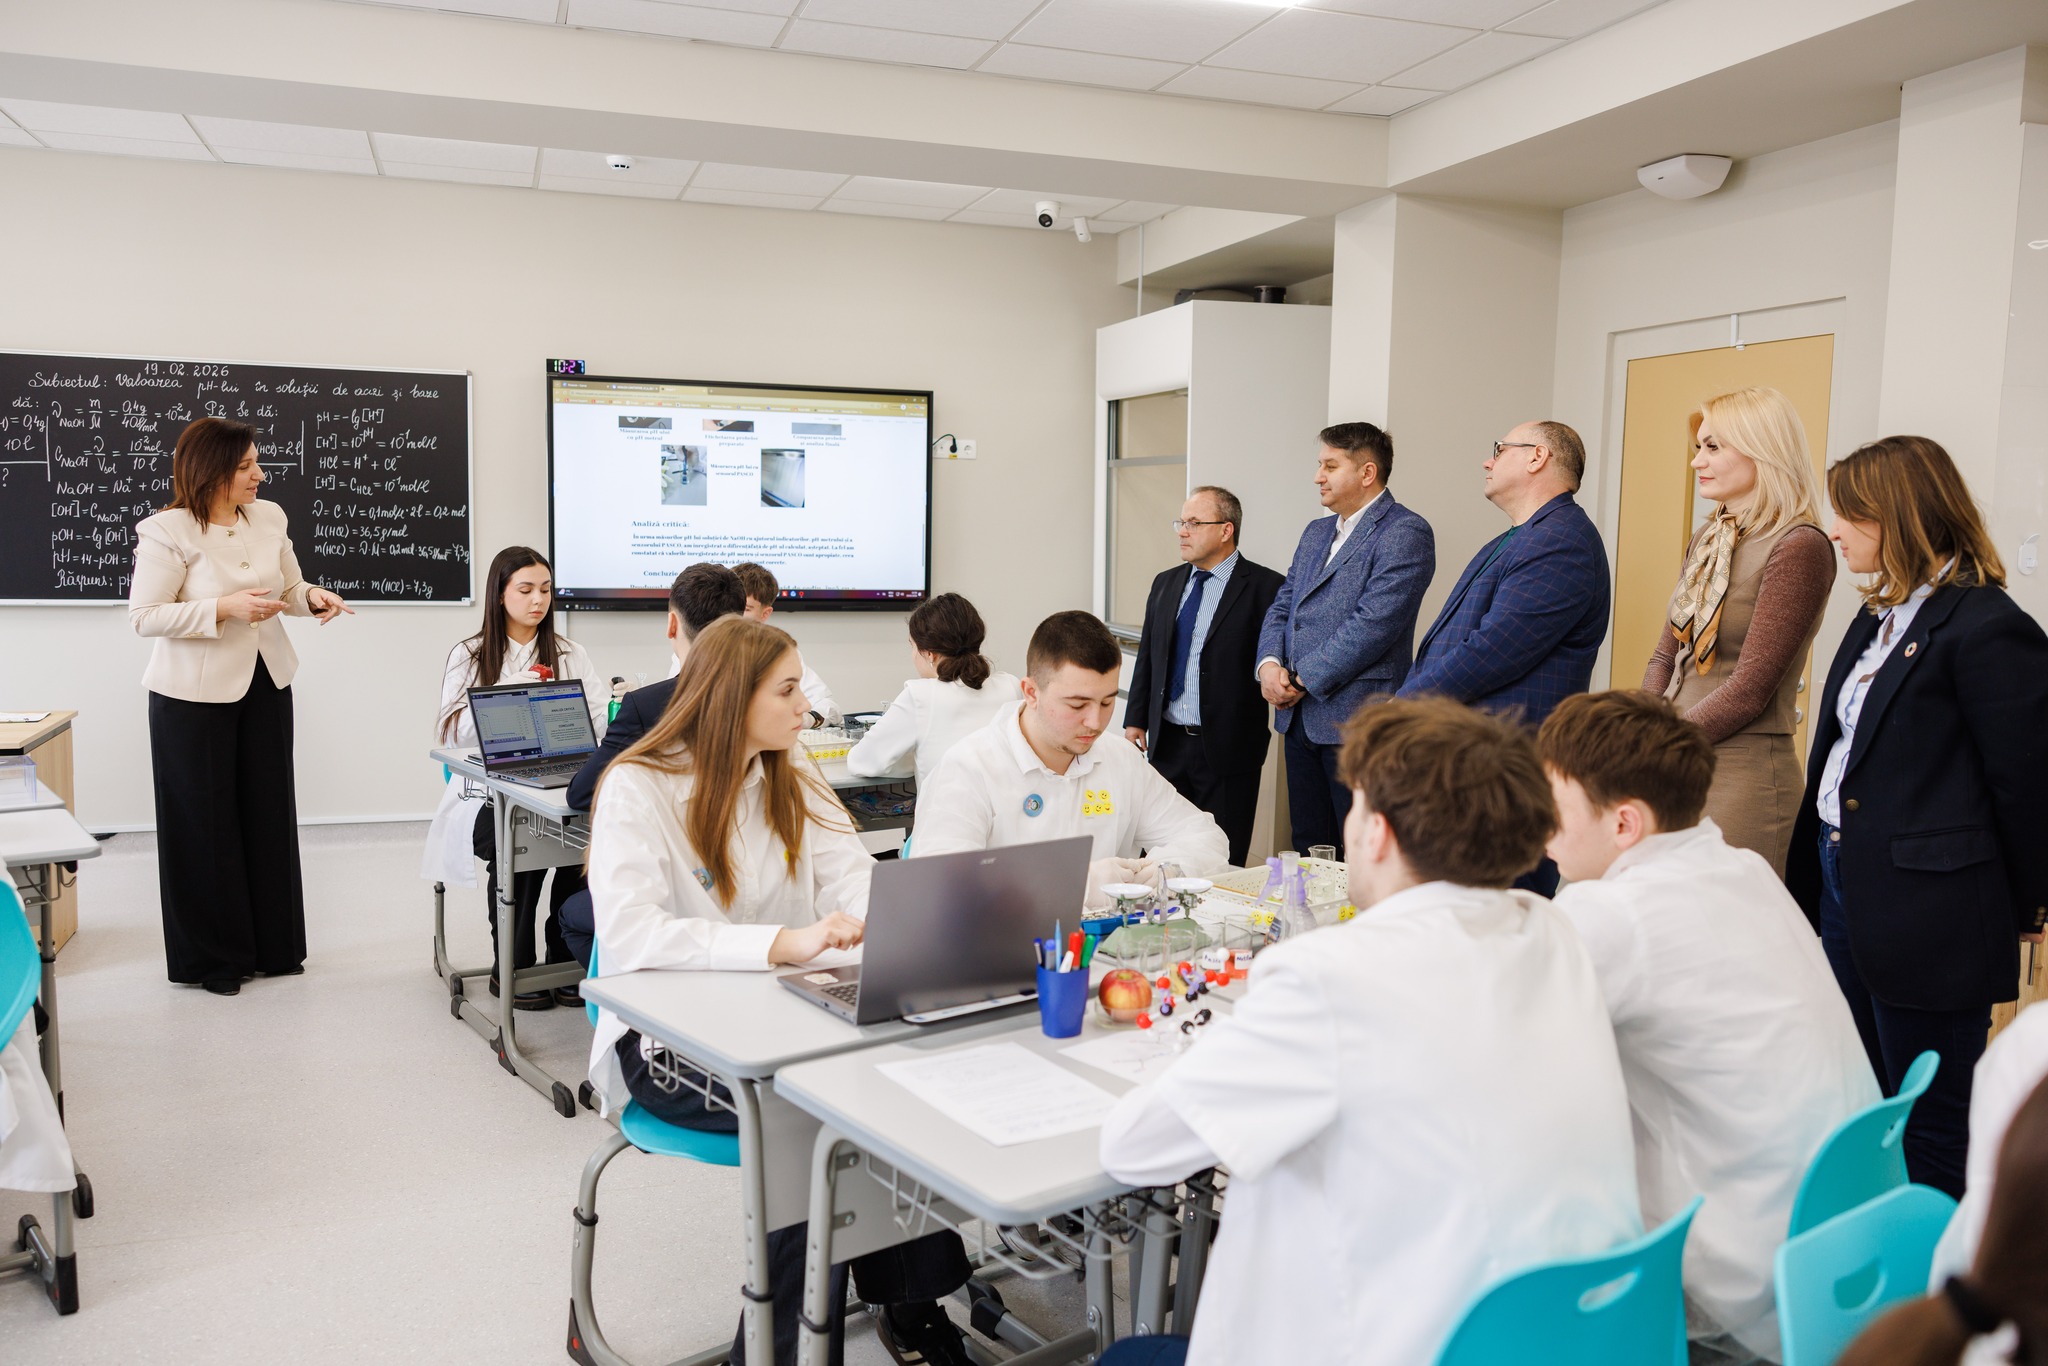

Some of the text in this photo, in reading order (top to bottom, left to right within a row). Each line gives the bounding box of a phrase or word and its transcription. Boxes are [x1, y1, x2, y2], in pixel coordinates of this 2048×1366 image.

[554, 359, 585, 374] 10:27
[115, 373, 183, 389] Valoarea
[254, 380, 269, 393] în
[332, 382, 349, 397] de
[354, 386, 385, 397] acizi
[409, 384, 440, 399] baze
